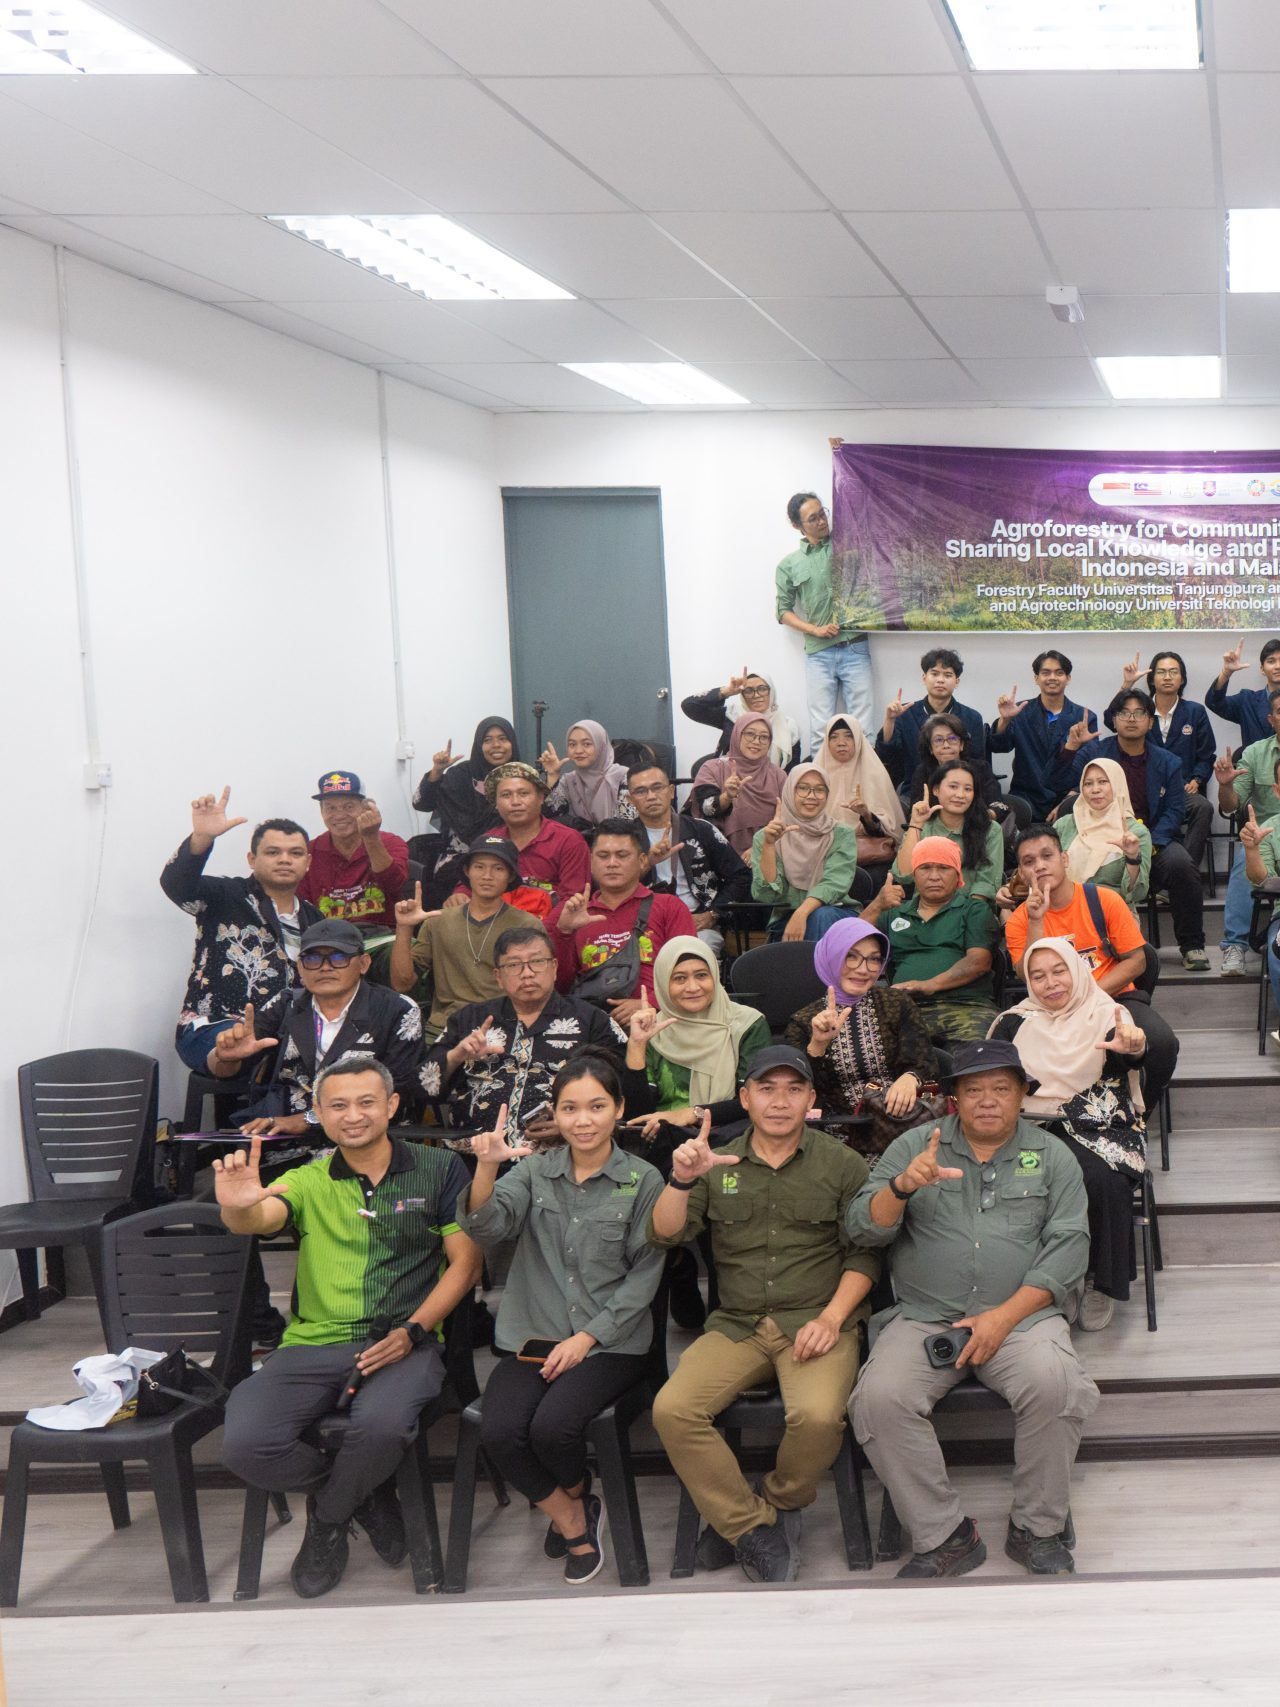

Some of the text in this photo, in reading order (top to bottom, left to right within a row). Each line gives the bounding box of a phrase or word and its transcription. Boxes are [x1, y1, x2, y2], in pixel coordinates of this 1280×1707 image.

[991, 519, 1132, 542] Agroforestry
[1136, 519, 1167, 538] for
[945, 539, 1031, 562] Sharing
[1036, 539, 1094, 557] Local
[1098, 538, 1222, 561] Knowledge
[1226, 538, 1267, 556] and
[1081, 558, 1189, 577] Indonesia
[1193, 558, 1234, 576] and
[976, 584, 1035, 599] Forestry
[1038, 583, 1090, 599] Faculty
[1093, 583, 1174, 597] Universitas
[1176, 582, 1265, 598] Tanjungpura
[989, 600, 1017, 612] and
[1021, 599, 1133, 614] Agrotechnology
[1136, 598, 1203, 611] Universiti
[1206, 597, 1275, 612] Teknologi
